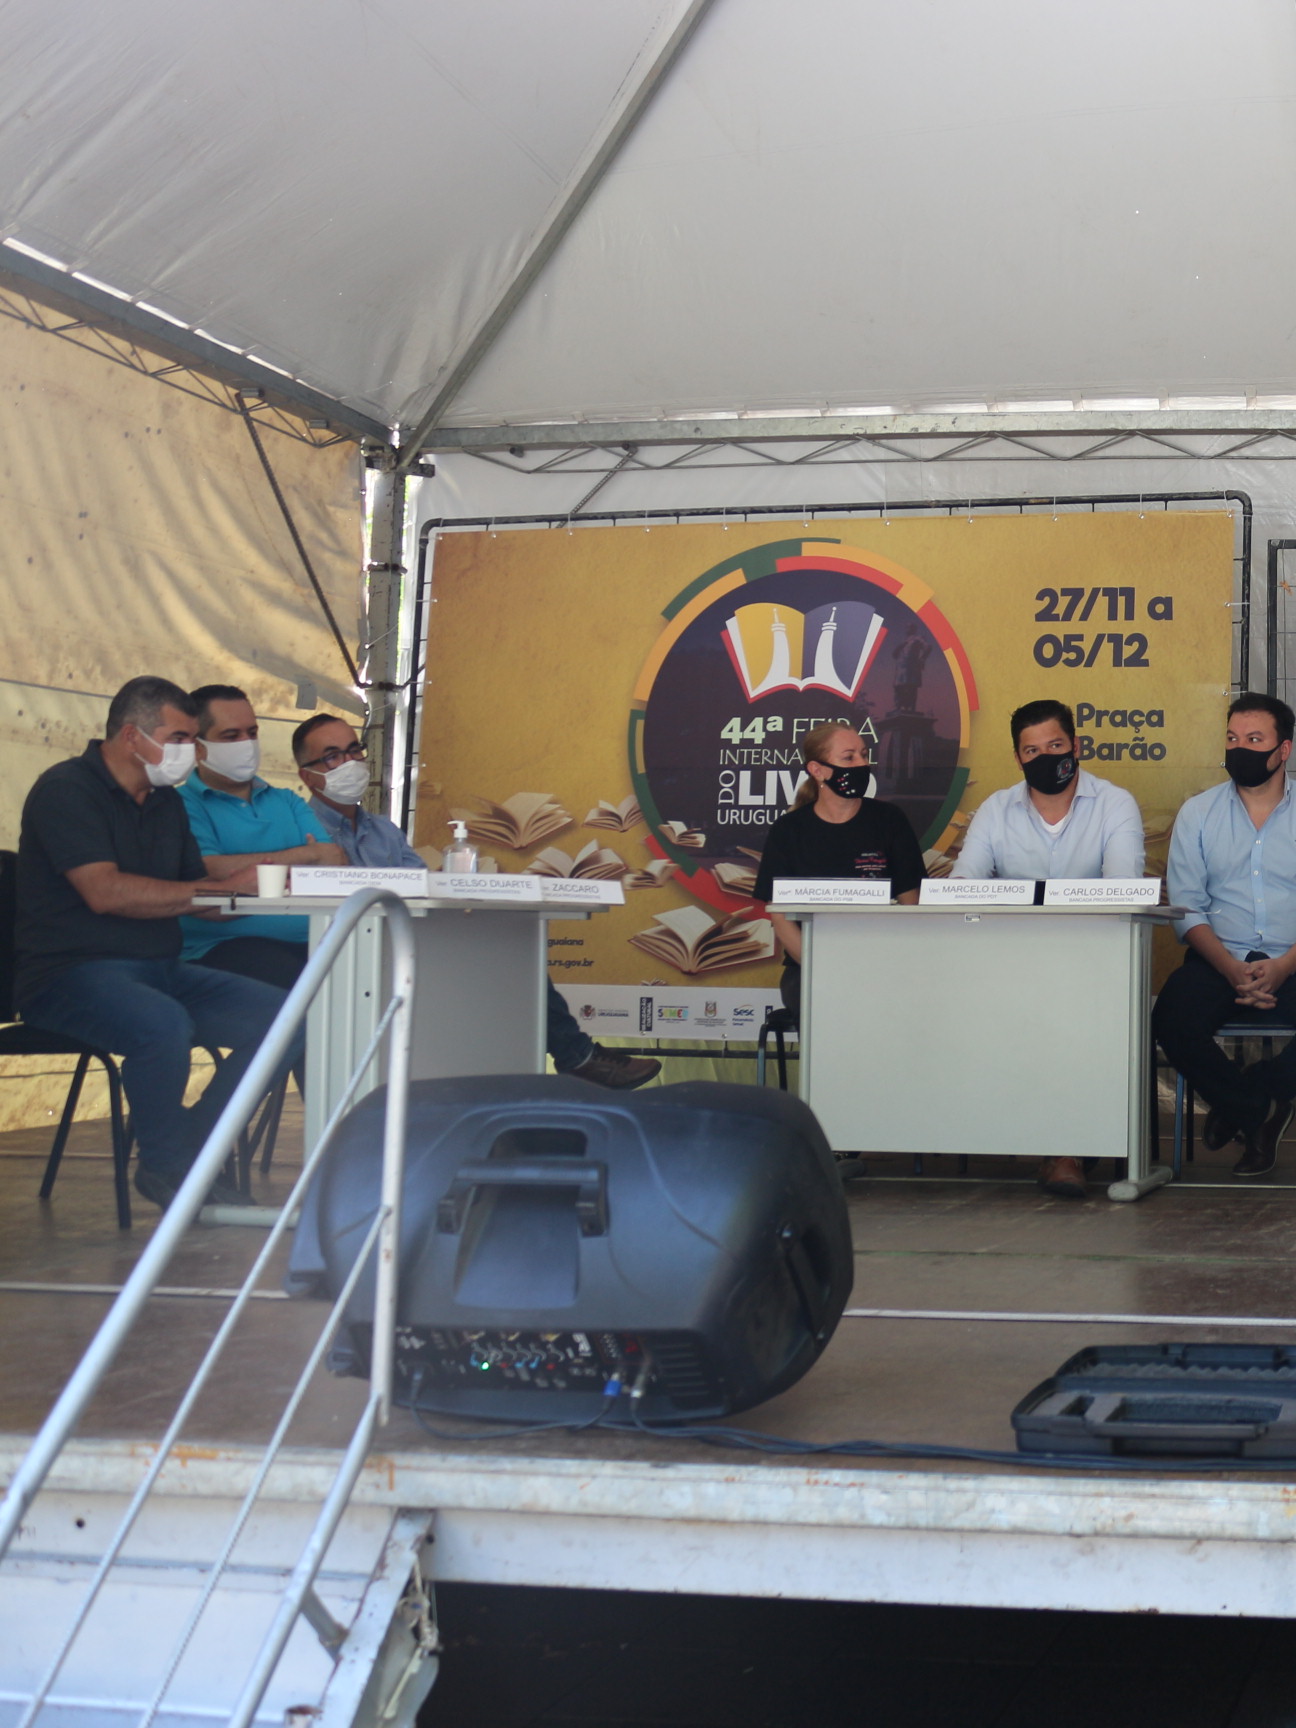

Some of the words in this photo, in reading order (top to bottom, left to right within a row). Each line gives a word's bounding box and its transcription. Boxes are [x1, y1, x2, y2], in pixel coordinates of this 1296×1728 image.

[1034, 587, 1136, 622] 27/11
[1147, 596, 1174, 621] a
[1033, 632, 1150, 668] 05/12
[1076, 702, 1165, 734] Praça
[1078, 735, 1167, 762] Barão
[718, 770, 736, 805] DO
[313, 870, 368, 880] CRISTIANO
[369, 871, 423, 881] BONAPACE
[450, 878, 487, 887] CELSO
[489, 879, 533, 889] DUARTE
[552, 882, 599, 894] ZACCARO
[941, 884, 990, 894] MARCELO
[991, 885, 1026, 894] LEMOS
[794, 887, 831, 896] MÁRCIA
[832, 888, 885, 897] FUMAGALLI
[1063, 887, 1104, 896] CARLOS
[1106, 887, 1155, 896] DELGADO
